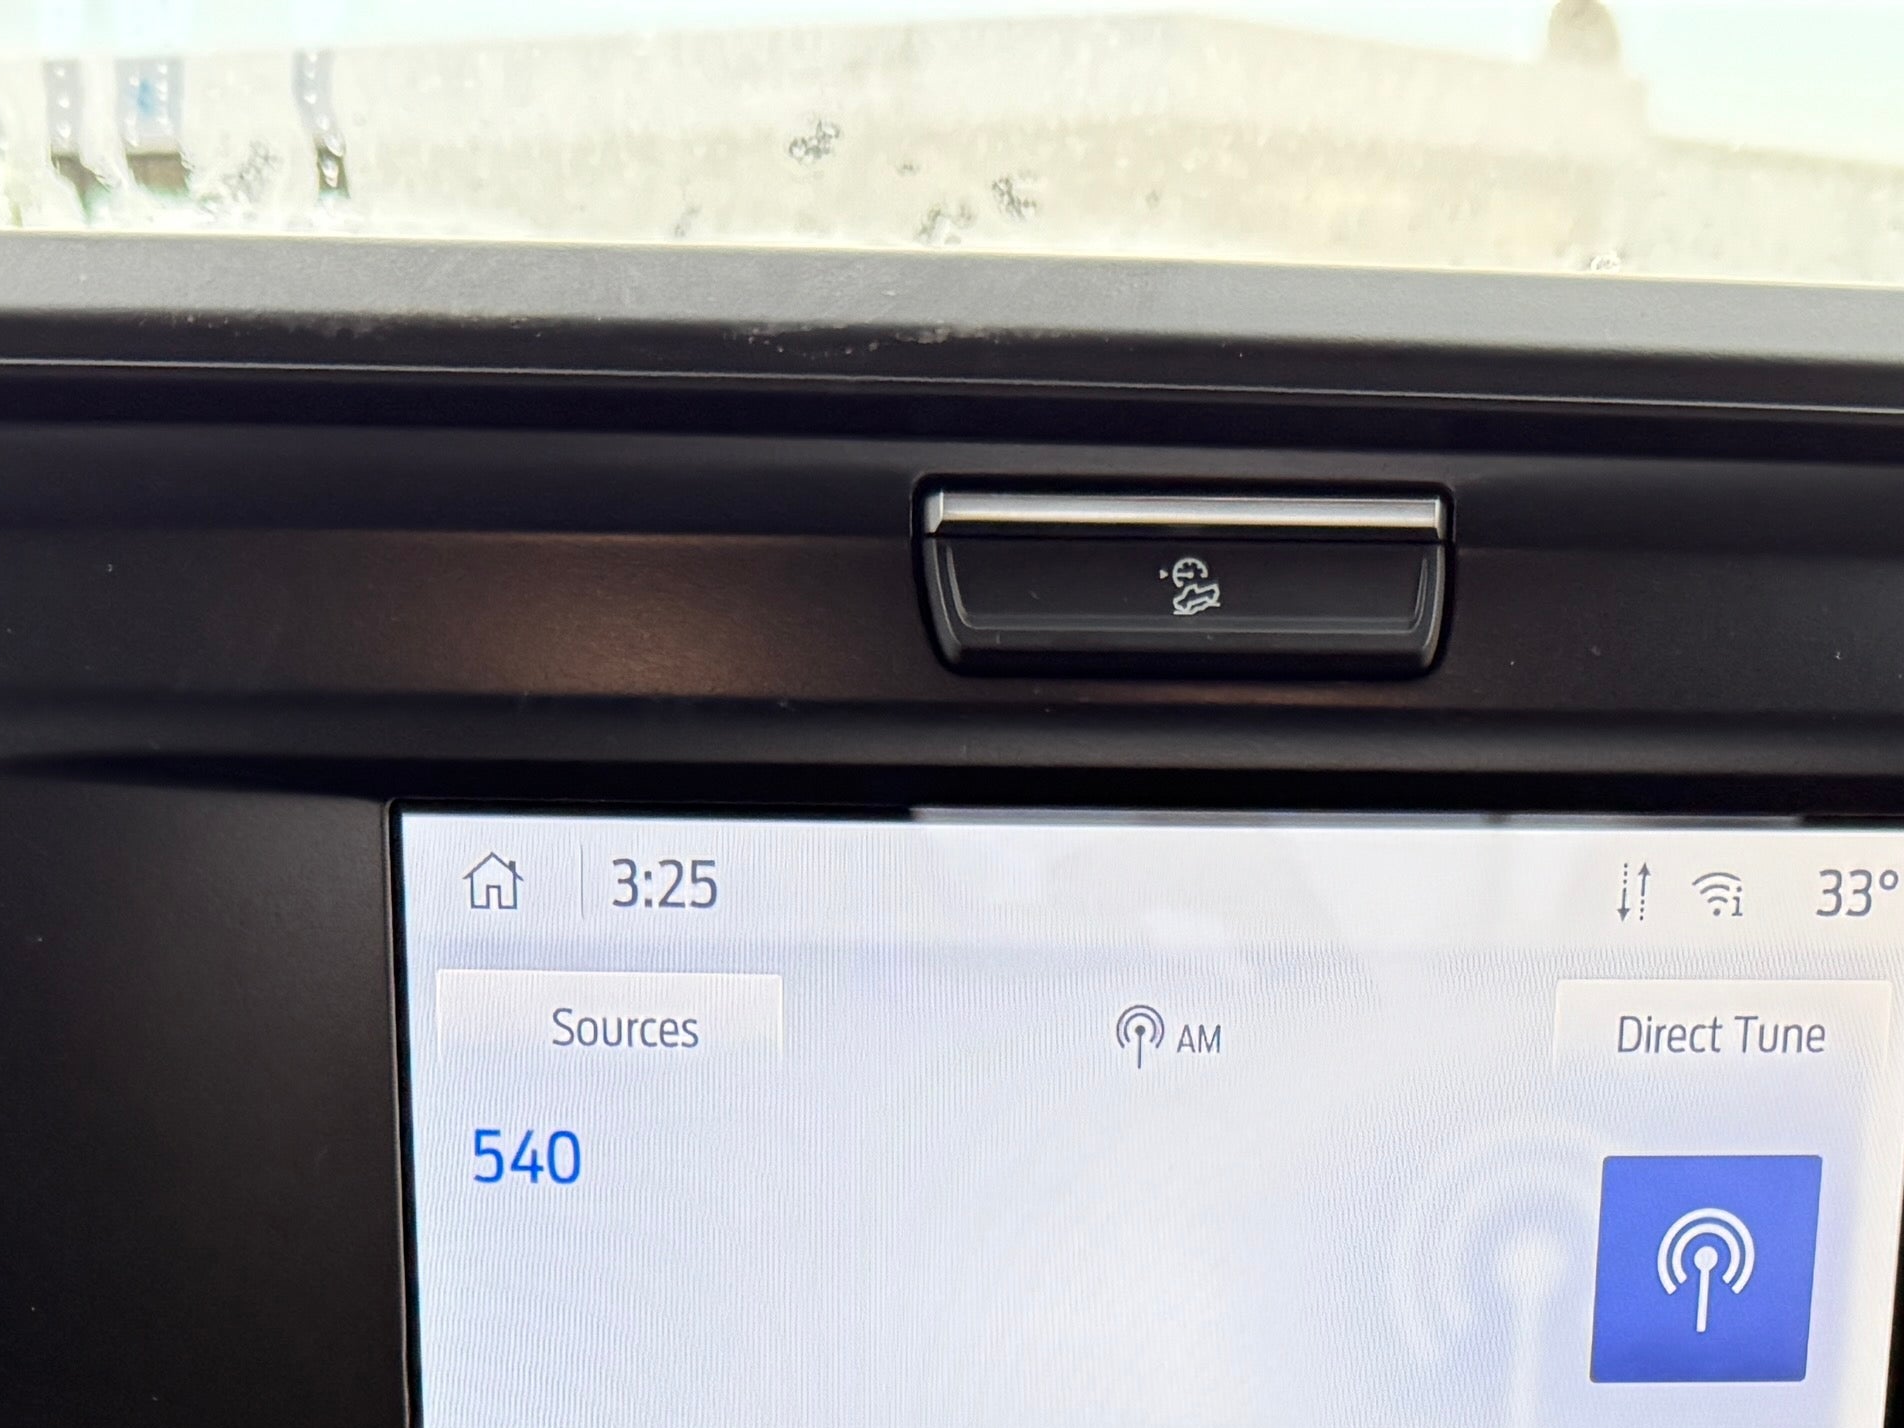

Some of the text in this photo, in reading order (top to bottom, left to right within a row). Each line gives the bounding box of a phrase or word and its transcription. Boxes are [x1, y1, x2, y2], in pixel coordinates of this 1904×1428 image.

[613, 858, 717, 908] 3:25
[1816, 869, 1898, 916] 33°
[553, 1008, 698, 1048] Sources
[1177, 1024, 1221, 1053] AM
[1618, 1016, 1825, 1053] Direct Tune
[474, 1129, 580, 1184] 540
